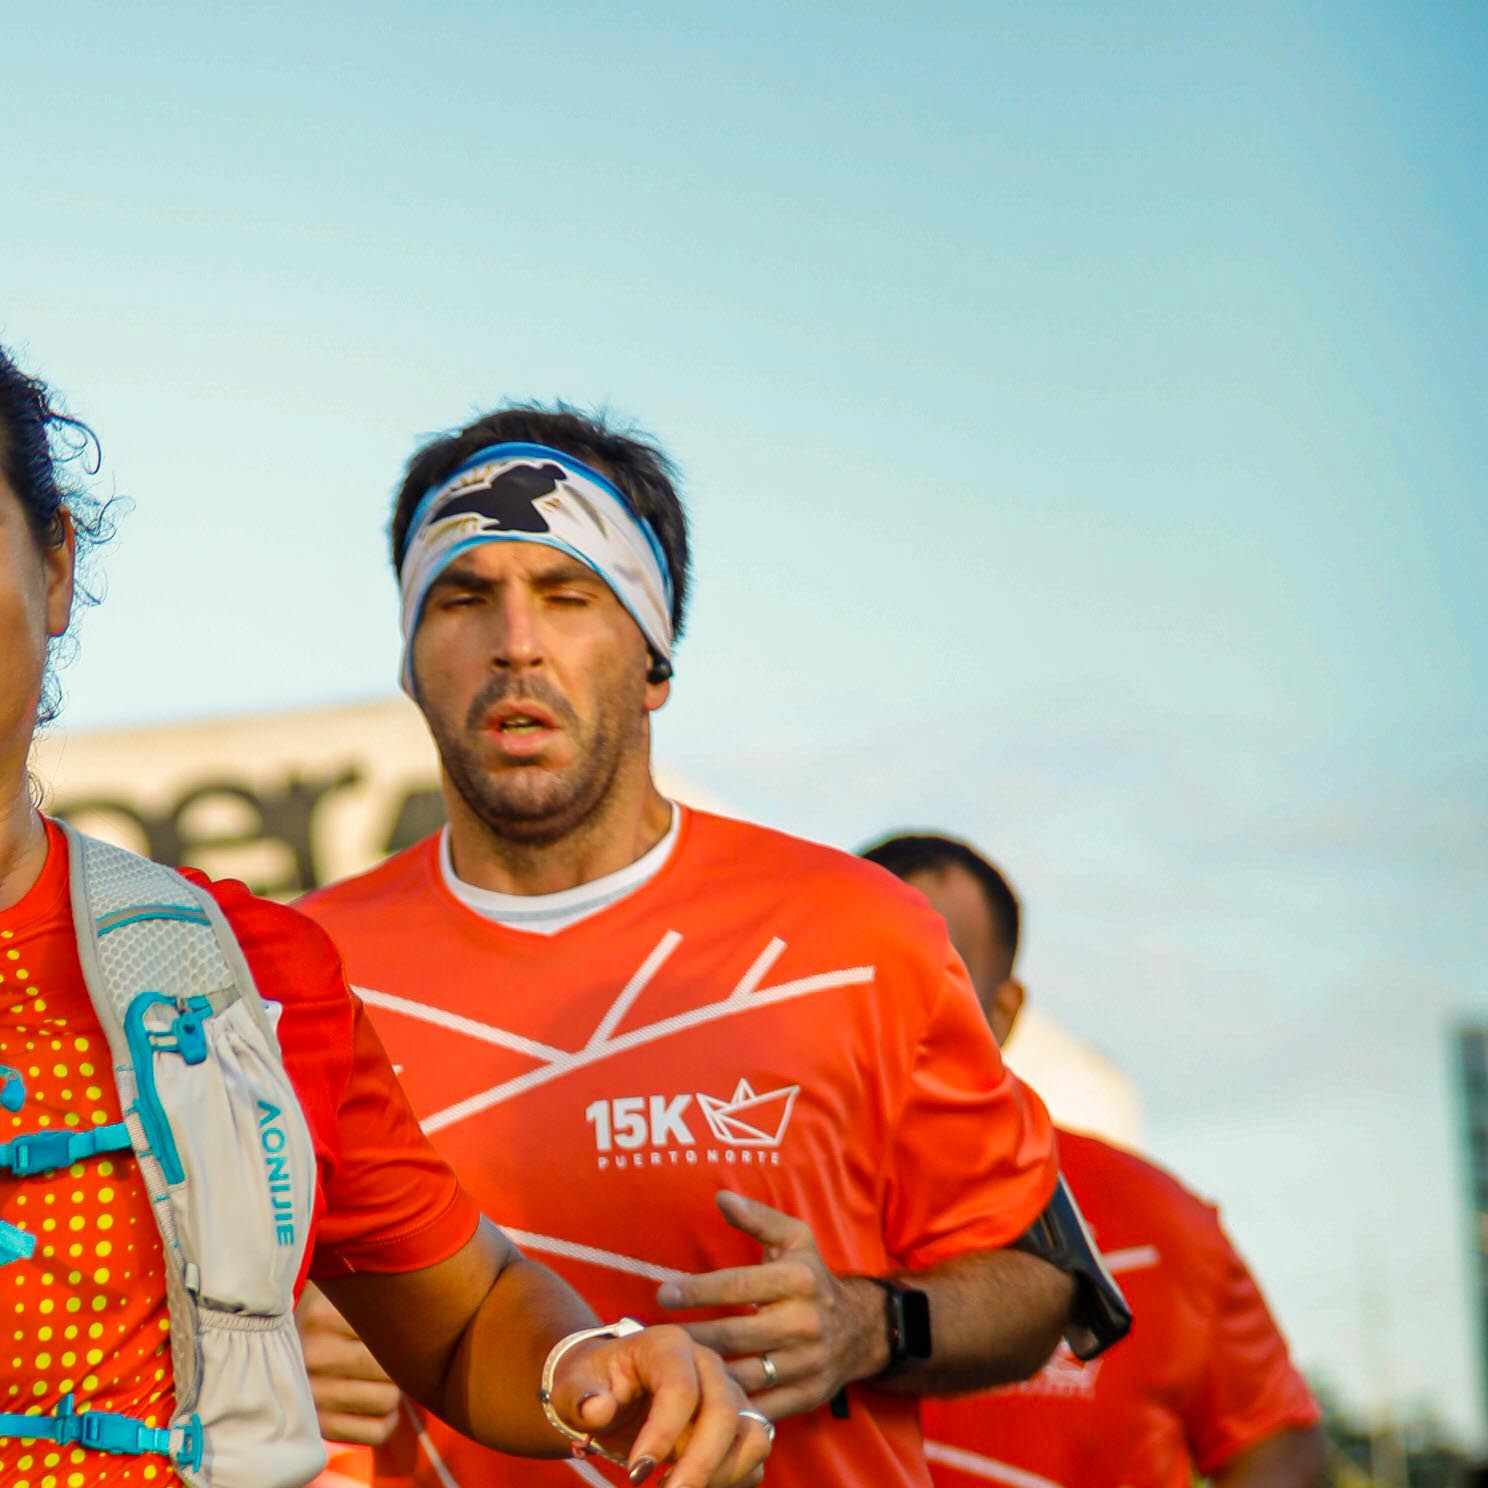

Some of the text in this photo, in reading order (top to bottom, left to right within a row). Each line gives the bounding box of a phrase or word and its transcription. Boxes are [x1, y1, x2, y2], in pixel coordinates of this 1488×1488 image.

[585, 1093, 696, 1151] 15K
[256, 1098, 295, 1247] AONIJIE
[597, 1148, 780, 1171] PUERTO NORTE
